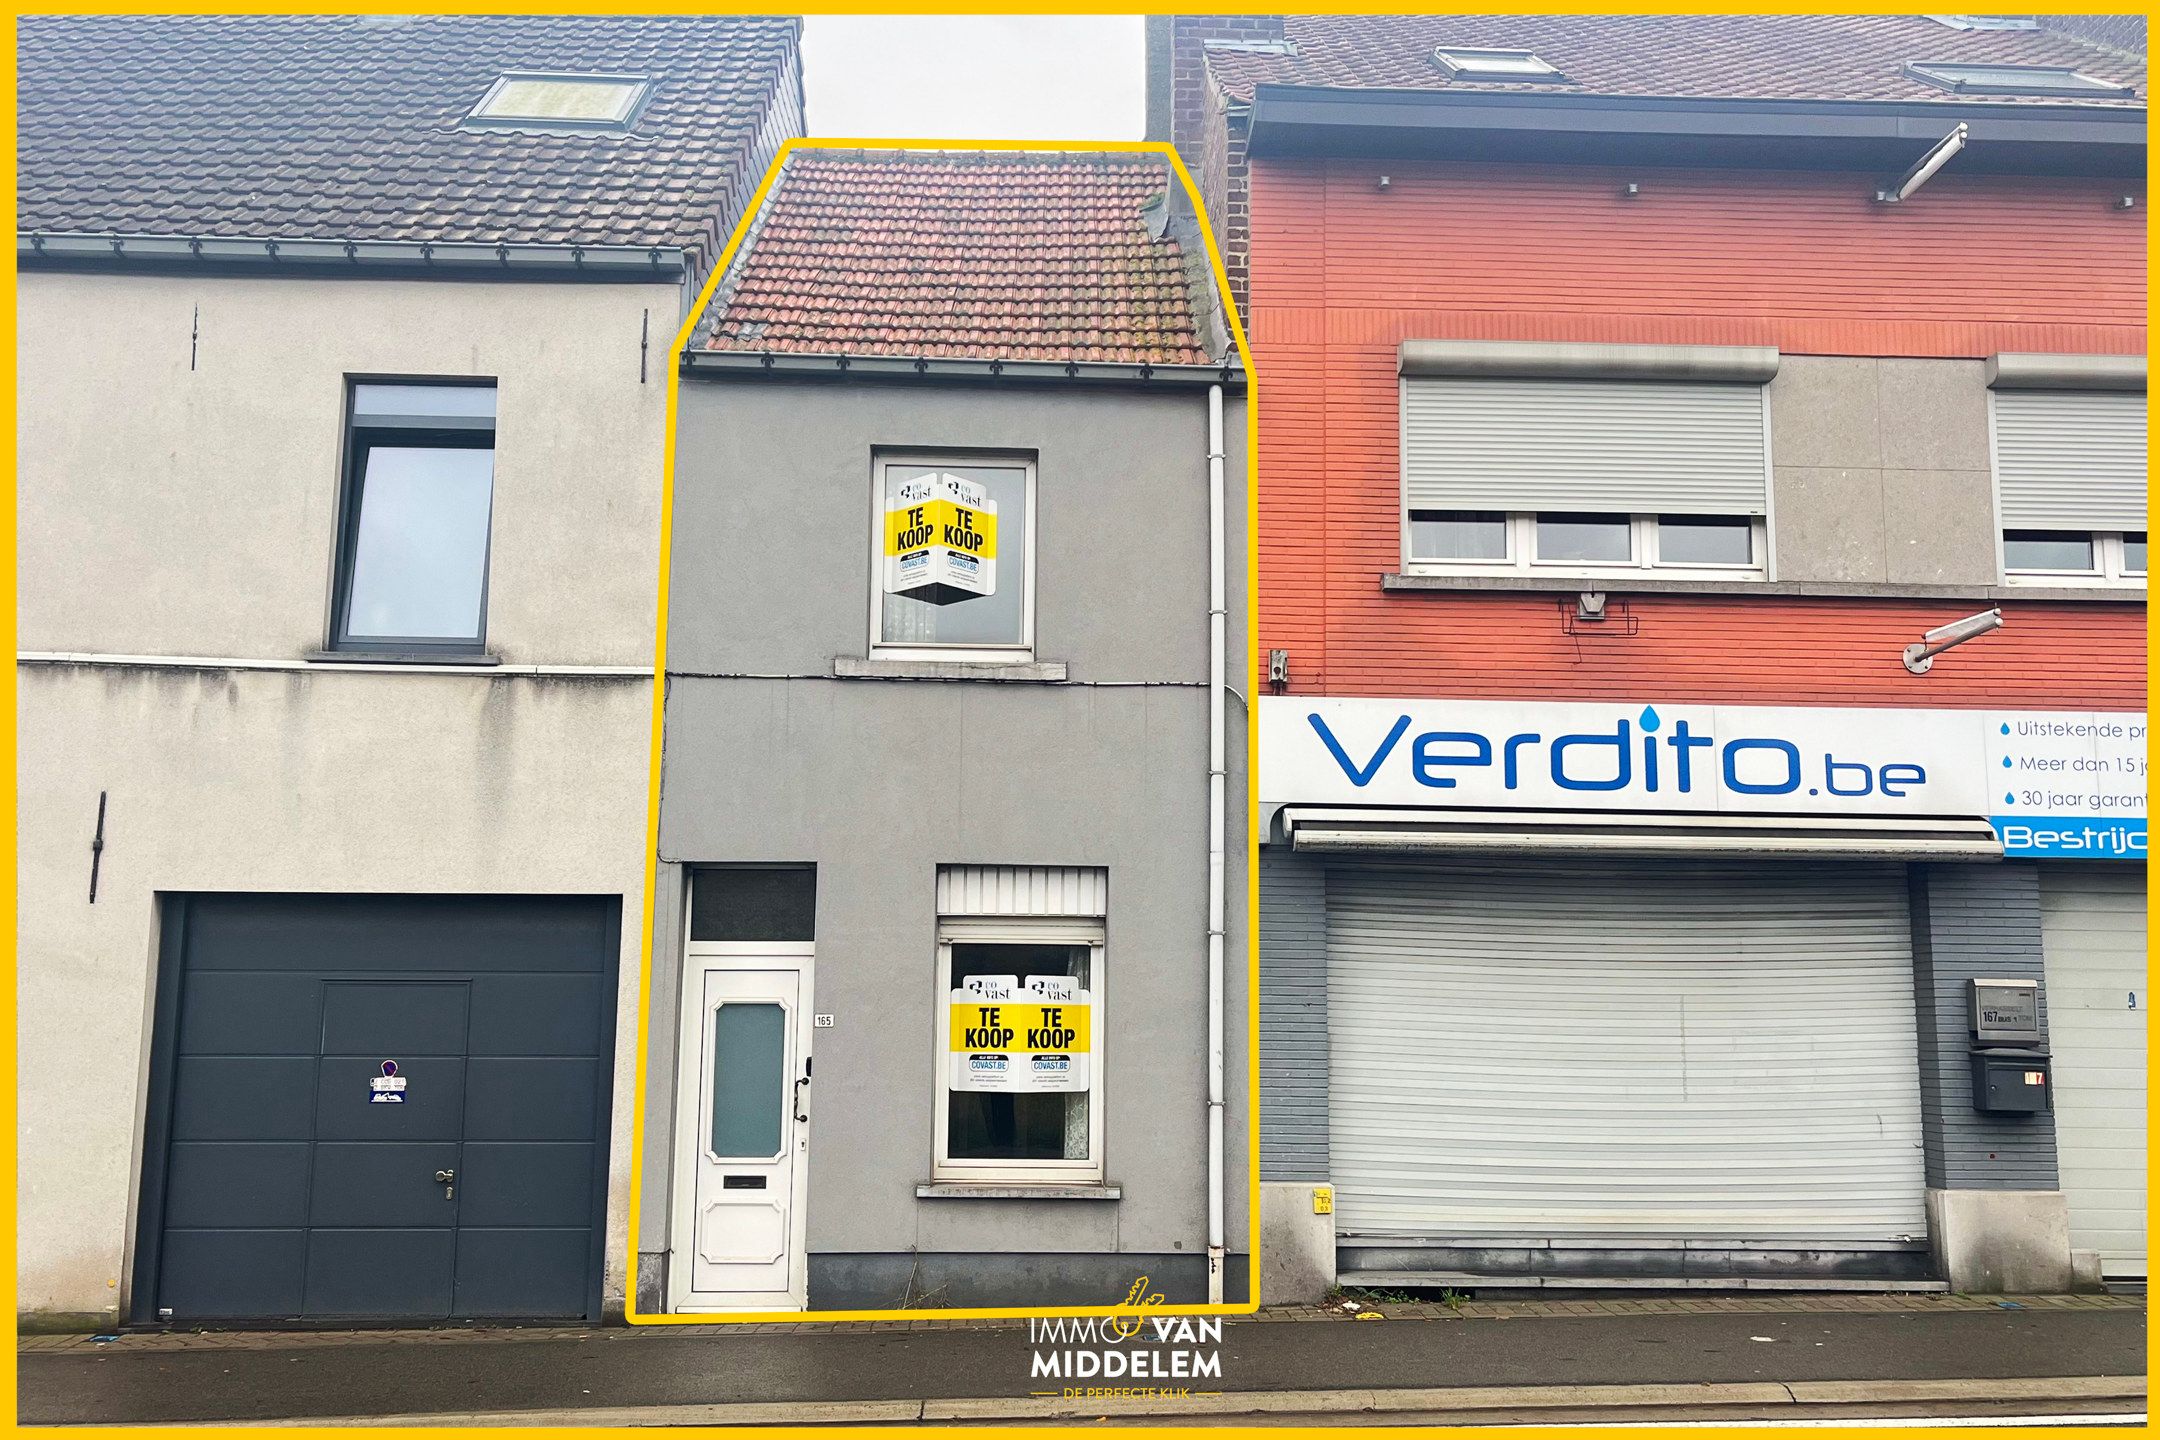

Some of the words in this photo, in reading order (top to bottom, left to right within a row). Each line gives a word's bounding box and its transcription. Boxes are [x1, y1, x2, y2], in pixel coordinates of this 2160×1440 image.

[912, 487, 932, 501] vast
[960, 493, 982, 507] vast
[908, 507, 924, 528] TE
[955, 508, 973, 530] TE
[897, 525, 934, 551] KOOP
[944, 525, 983, 552] KOOP
[2017, 721, 2123, 738] Uitstekende
[1307, 703, 1927, 797] Verdito.be
[2020, 757, 2066, 771] Meer
[2072, 757, 2109, 772] dan
[2116, 758, 2135, 772] 15
[2022, 791, 2043, 806] 30
[2047, 791, 2083, 810] jaar
[985, 989, 1011, 1000] vast
[1047, 989, 1073, 1001] vast
[817, 1016, 831, 1026] 165
[979, 1007, 1000, 1027] TE
[1041, 1008, 1062, 1028] TE
[1983, 1011, 1998, 1023] 167
[965, 1028, 1014, 1048] KOOP
[1027, 1029, 1076, 1049] KOOP
[971, 1061, 1006, 1070] COVAST.BE
[1033, 1062, 1068, 1070] COVAST.BE
